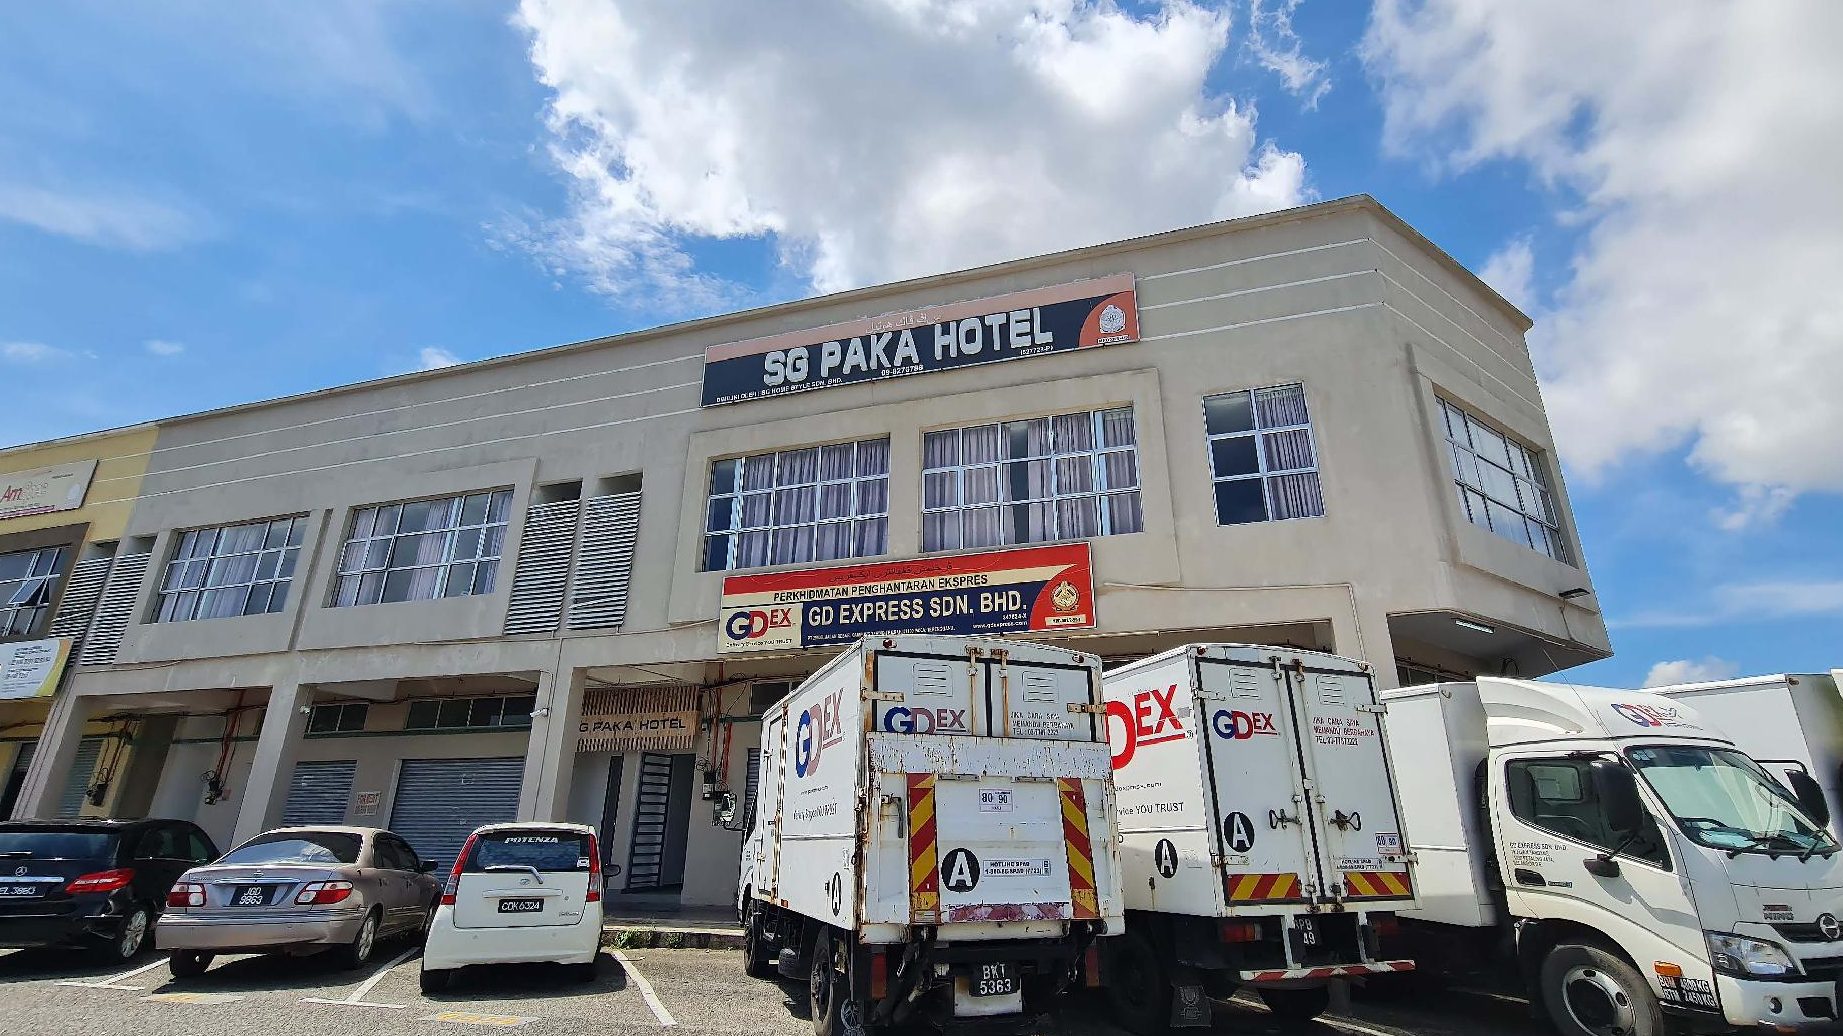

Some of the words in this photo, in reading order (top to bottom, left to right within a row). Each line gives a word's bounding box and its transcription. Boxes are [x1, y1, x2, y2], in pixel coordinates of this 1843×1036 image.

[763, 347, 809, 387] SG
[820, 329, 920, 378] PAKA
[934, 307, 1054, 361] HOTEL
[771, 385, 789, 394] HOME
[773, 586, 849, 602] PERKHIDMATAN
[851, 578, 935, 596] PENGHANTARAN
[938, 574, 988, 588] EKSPRES
[808, 605, 834, 627] GD
[839, 598, 924, 625] EXPRESS
[929, 594, 974, 618] SDN.
[980, 590, 1027, 614] BHD.
[725, 608, 793, 641] GDEX
[579, 722, 589, 733] G
[592, 721, 634, 732] PAKA
[640, 718, 686, 730] HOTEL
[796, 688, 844, 778] GDEX
[884, 706, 967, 734] GDEX
[1105, 684, 1184, 770] DEX
[1213, 709, 1276, 740] GDEX
[982, 792, 993, 803] 80
[998, 794, 1008, 804] 90
[1135, 804, 1153, 814] YOU
[1154, 802, 1184, 813] TRUST
[504, 836, 559, 844] POTENZA
[1233, 813, 1251, 848] A
[949, 851, 973, 887] A
[1160, 840, 1174, 875] A
[982, 962, 1006, 980] BKT
[980, 978, 1012, 995] 5363
